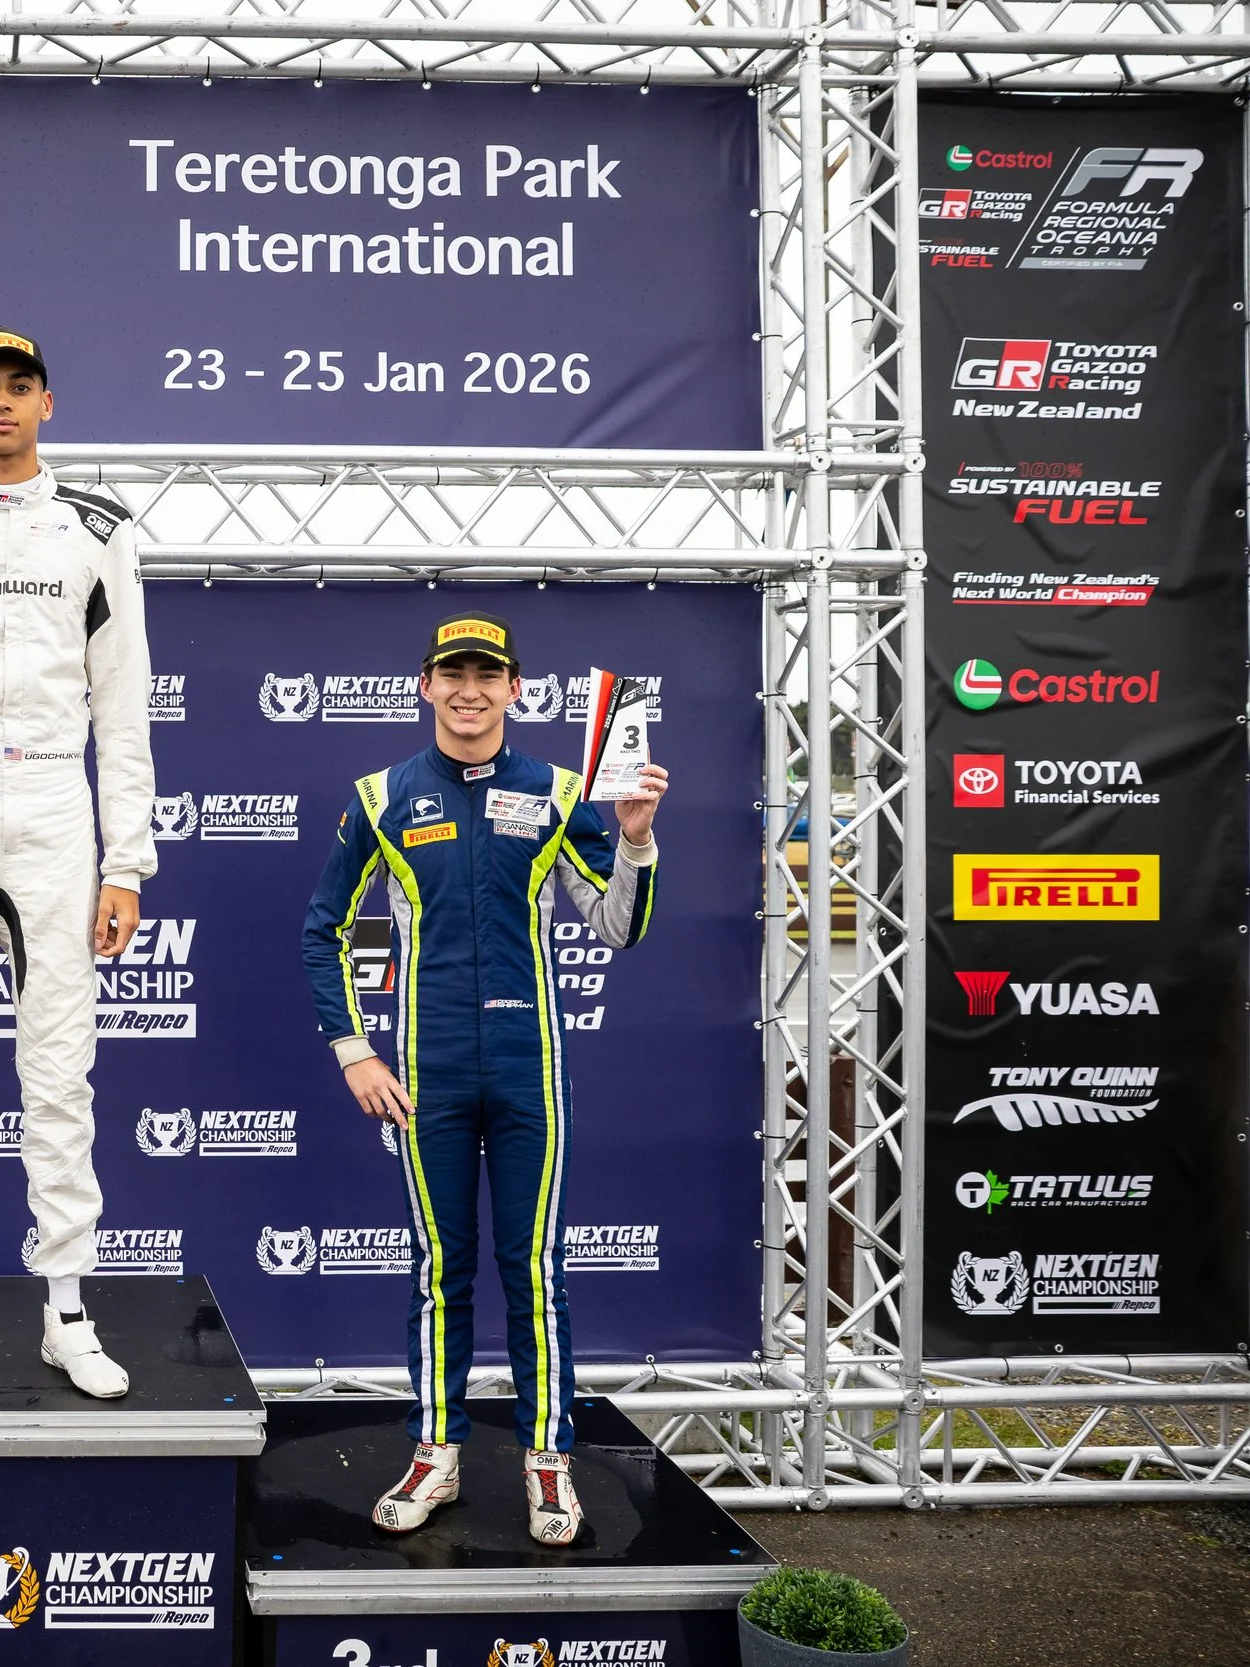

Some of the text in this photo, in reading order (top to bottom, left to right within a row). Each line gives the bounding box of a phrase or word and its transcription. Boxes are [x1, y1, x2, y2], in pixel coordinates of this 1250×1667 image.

[976, 150, 1053, 169] Castrol
[129, 140, 621, 210] Teretonga Park
[970, 210, 1023, 222] Racing
[1051, 201, 1175, 215] FORMULA
[1042, 216, 1167, 229] REGIONAL
[1036, 230, 1158, 245] OCEANIA
[179, 219, 574, 276] International
[919, 245, 999, 254] STAINABLE
[931, 255, 993, 267] FUEL
[164, 349, 591, 394] 23 25 Jan 2026
[957, 358, 1041, 387] GR
[1048, 376, 1141, 395] Racing
[952, 399, 1143, 419] New Zealand
[1018, 462, 1084, 477] 100%
[948, 479, 1162, 496] SUSTAINABLE
[1013, 499, 1148, 524] FUEL
[86, 515, 112, 534] OMP
[953, 572, 1159, 585] Finding New Zealand's
[952, 587, 1146, 603] Next World Champion
[444, 623, 499, 640] PIRELLI
[323, 676, 420, 694] NEXTGEN
[1008, 669, 1159, 703] Castrol
[322, 696, 419, 708] CHAMPIONSHIP
[623, 725, 640, 749] 3
[1015, 761, 1142, 784] TOYOTA
[362, 779, 377, 809] ARINA
[1015, 790, 1160, 804] Financial Services
[410, 826, 450, 843] PIRELLI
[972, 868, 1140, 906] PIRELLI
[1009, 983, 1159, 1015] YUASA
[115, 1010, 189, 1032] Repco
[989, 1067, 1158, 1086] TONY QUINN
[1091, 1089, 1152, 1097] FOUNDATION
[200, 1111, 297, 1128] NEXTGEN
[200, 1130, 296, 1142] CHAMPIONSHIP
[1009, 1175, 1153, 1198] TATUUS
[564, 1226, 659, 1244] NEXTGEN
[565, 1245, 658, 1256] CHAMPIONSHIP
[1034, 1254, 1159, 1277] NEXTGEN
[1034, 1280, 1158, 1295] CHAMPIONSHIP
[382, 1504, 395, 1525] OMP
[46, 1553, 215, 1582] NEXTGEN
[46, 1585, 212, 1605] CHAMPIONSHIP
[164, 1611, 209, 1625] Repco
